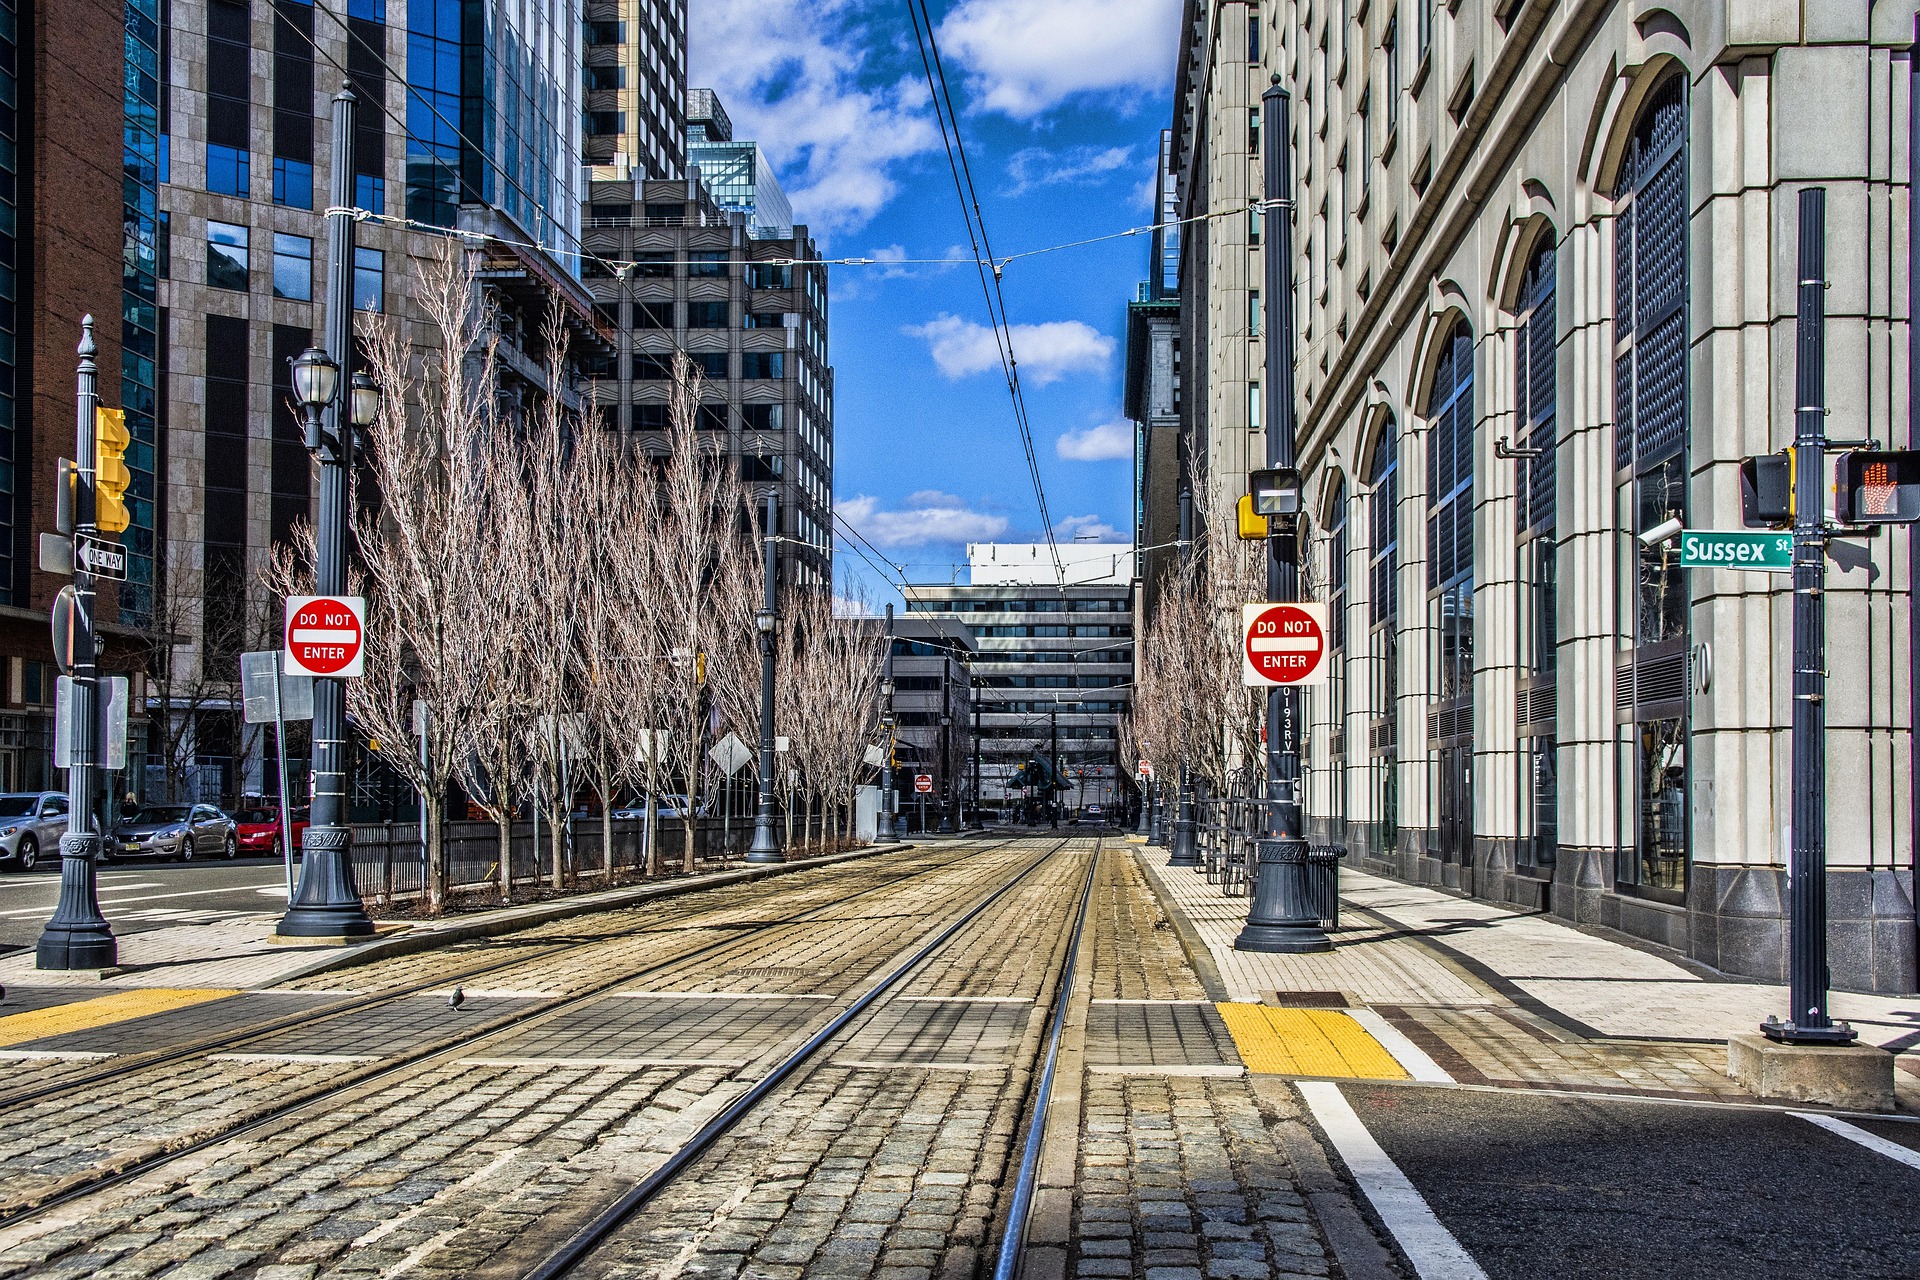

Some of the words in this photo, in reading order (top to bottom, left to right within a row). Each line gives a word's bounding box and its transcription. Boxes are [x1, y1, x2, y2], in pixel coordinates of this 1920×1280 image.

[1685, 537, 1765, 561] Sussex
[1775, 538, 1788, 551] St
[89, 549, 103, 564] ONE
[105, 552, 122, 569] WAY
[300, 613, 318, 625] DO
[325, 613, 351, 626] NOT
[1257, 621, 1276, 634] DO
[1284, 620, 1312, 634] NOT
[303, 646, 345, 659] ENTER
[1263, 655, 1307, 668] ENTER
[1282, 686, 1292, 751] 0193RV
